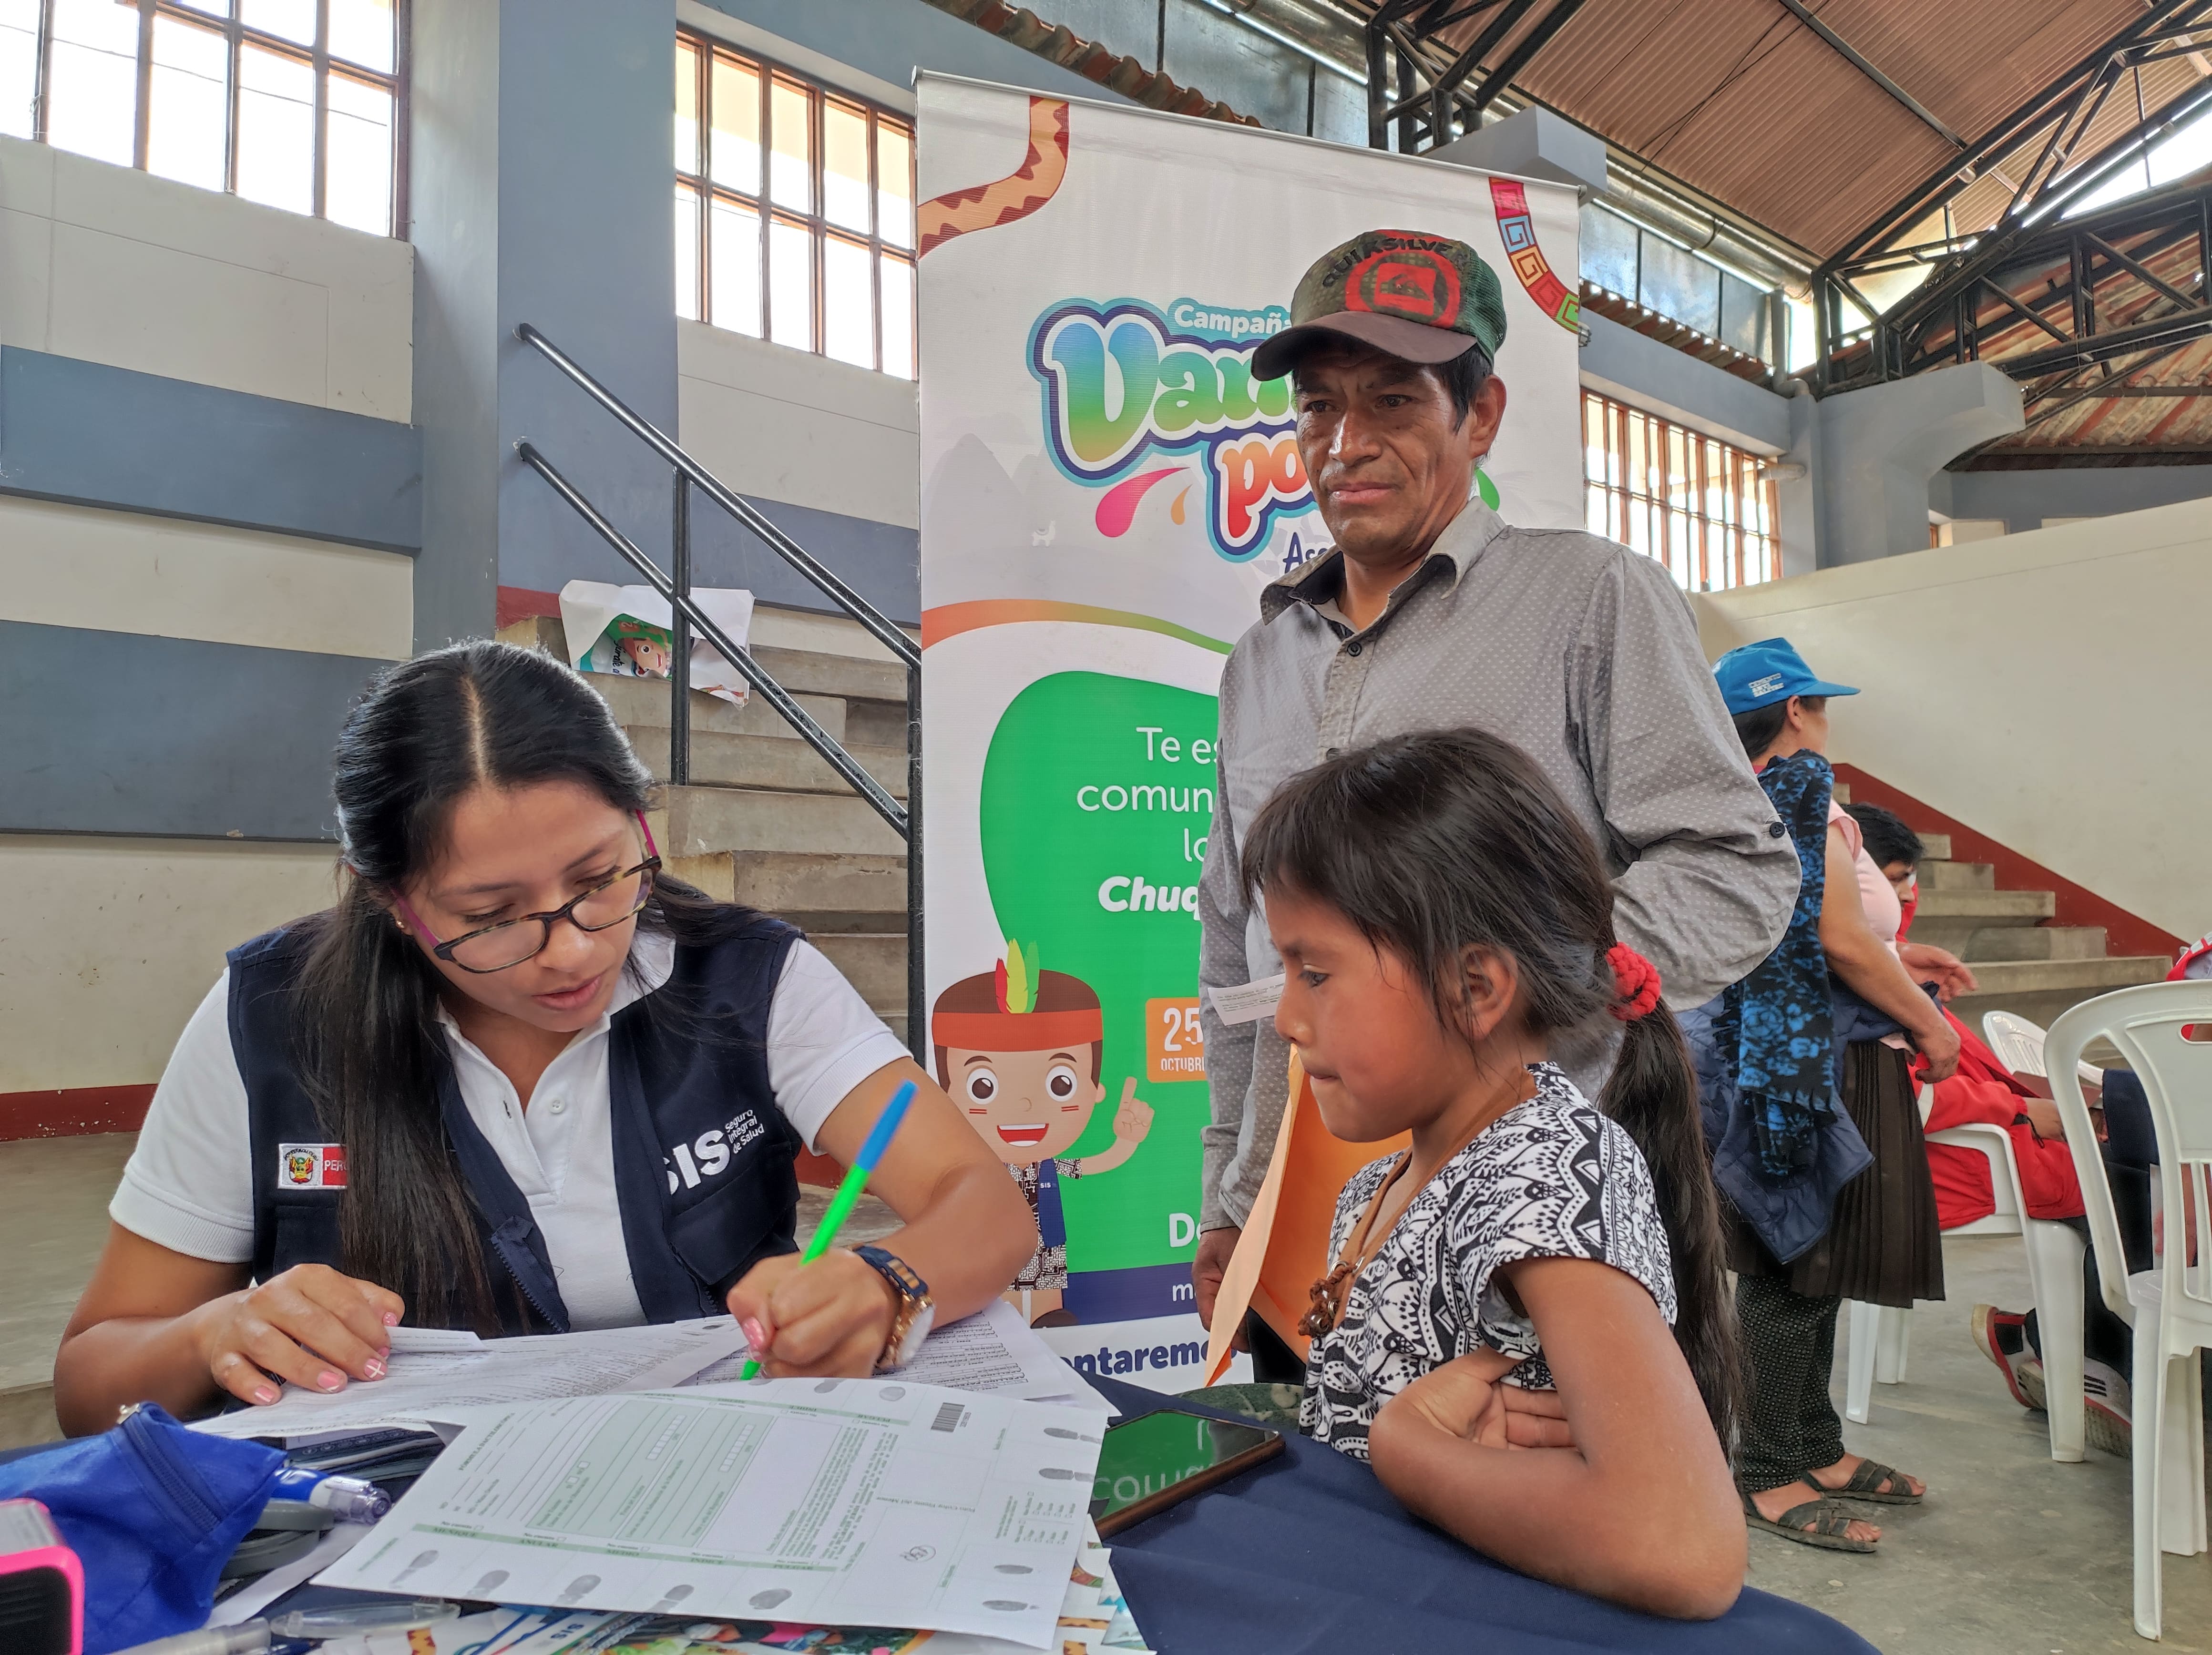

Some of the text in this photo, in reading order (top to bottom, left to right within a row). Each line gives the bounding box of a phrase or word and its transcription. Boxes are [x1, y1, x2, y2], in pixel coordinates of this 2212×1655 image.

[1136, 727, 1181, 763] Te
[1076, 785, 1214, 813] comun
[1164, 1007, 1204, 1052] 25
[728, 1115, 758, 1144] Integral
[733, 1123, 765, 1154] de Salud
[324, 1160, 347, 1172] PER
[1169, 1212, 1201, 1248] D
[1172, 1283, 1197, 1302] m
[1060, 1341, 1238, 1376] ntarem
